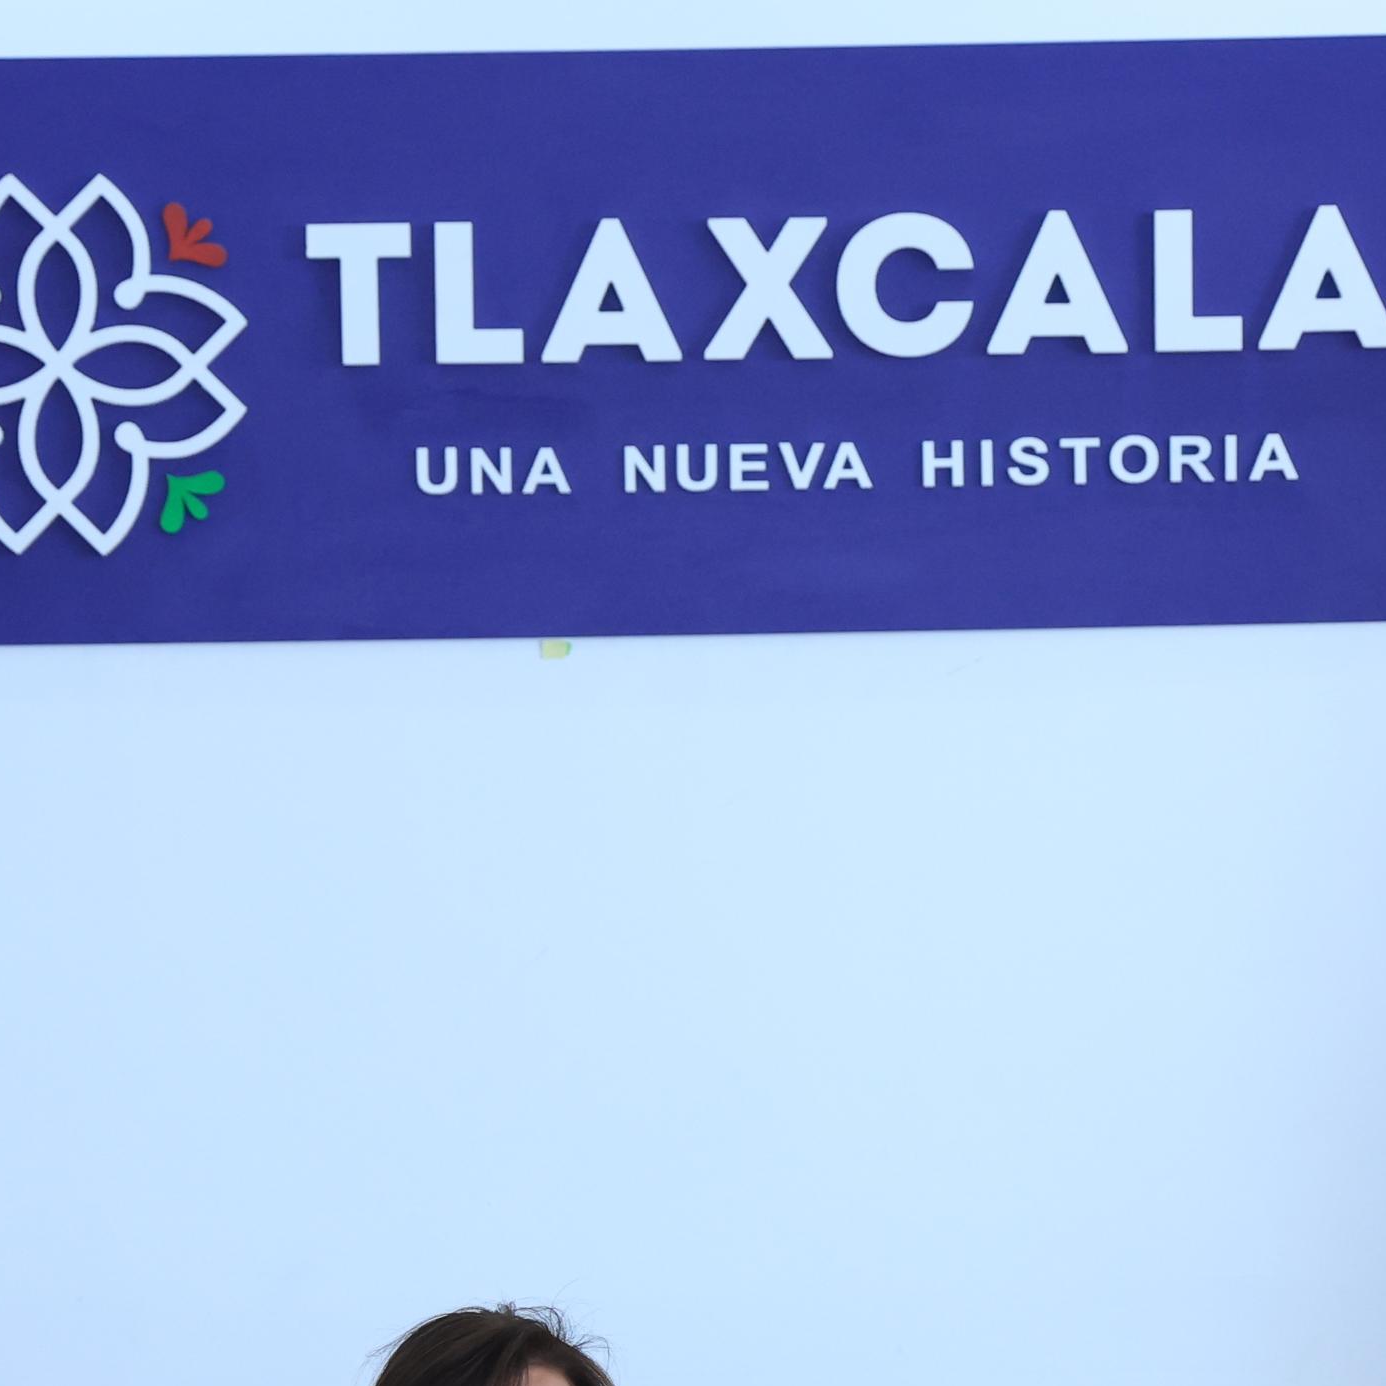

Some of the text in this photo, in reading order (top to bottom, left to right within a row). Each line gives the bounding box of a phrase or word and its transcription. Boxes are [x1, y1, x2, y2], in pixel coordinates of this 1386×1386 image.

[416, 433, 1299, 495] UNA NUEVA HISTORIA
